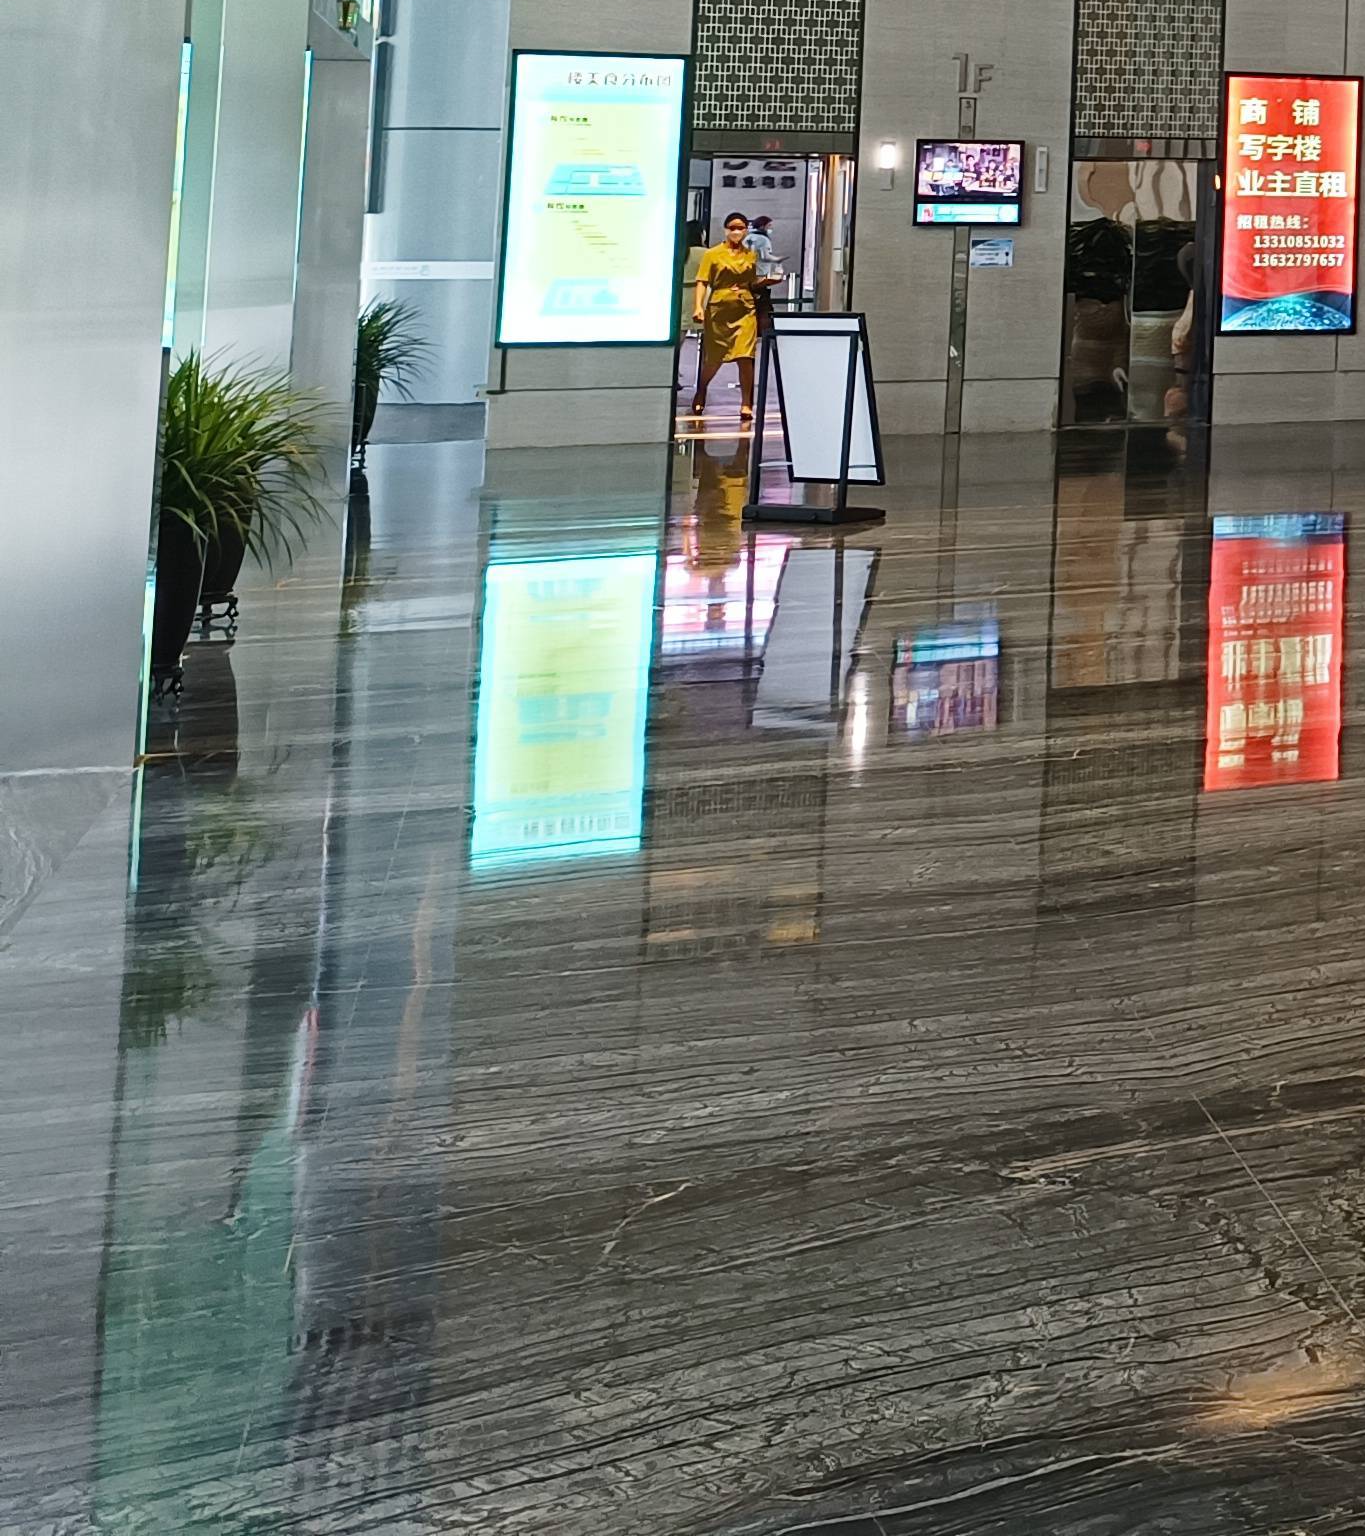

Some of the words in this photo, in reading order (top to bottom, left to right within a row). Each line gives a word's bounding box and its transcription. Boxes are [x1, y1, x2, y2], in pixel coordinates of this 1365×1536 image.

[952, 52, 994, 93] 1F
[1237, 134, 1322, 162] 写字楼
[1236, 169, 1348, 198] 业主直租
[1253, 235, 1345, 249] 13310851032
[1252, 253, 1344, 267] 13632797657
